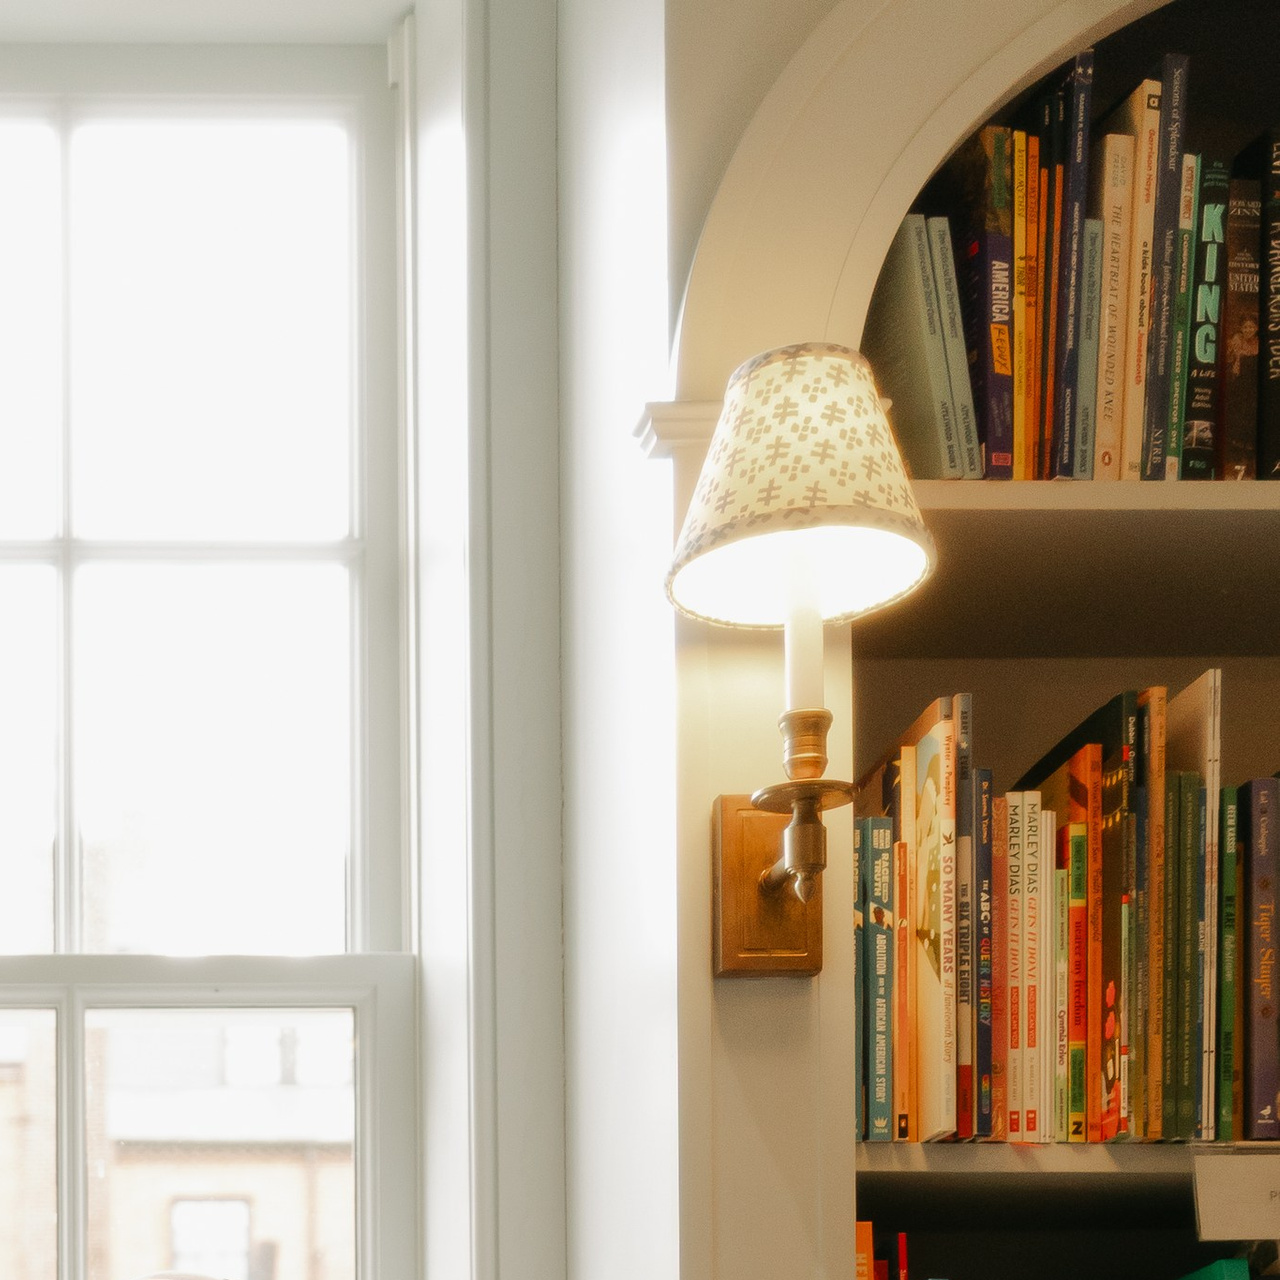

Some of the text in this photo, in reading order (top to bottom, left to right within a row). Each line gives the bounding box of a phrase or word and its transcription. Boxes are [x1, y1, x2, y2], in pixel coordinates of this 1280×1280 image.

[1168, 68, 1182, 172] Seasons of Splendour
[1144, 129, 1155, 203] Garrison Hayes
[1228, 208, 1261, 217] ZINN
[1179, 234, 1190, 293] COMPUTERS
[1194, 203, 1227, 364] KING
[1228, 273, 1260, 283] UNITED
[1228, 283, 1260, 293] STATES
[992, 260, 1009, 371] AMERICA REDUX
[1103, 205, 1122, 421] THE HEARTBEAT OF WOUNDED KNEE
[1135, 250, 1149, 385] kids book about Juneteenth
[1190, 370, 1216, 378] A LIFE
[943, 735, 954, 806] Wynter Pumphrey
[873, 859, 882, 896] TRUTH
[882, 853, 890, 882] RACE
[943, 856, 954, 875] SO
[943, 880, 954, 922] MANY
[1009, 805, 1021, 981] MARLEY DIAS GETS IT DONE
[1027, 804, 1039, 981] MARLEY DIAS GETS IT DONE
[943, 928, 954, 974] YEARS
[959, 901, 970, 1005] SIX TRIPLE EIGHT
[980, 938, 991, 1026] QUEER HISTORY
[1072, 921, 1084, 1026] nearer my freedom
[1254, 904, 1275, 1000] Tiger Slayer
[876, 934, 886, 1102] ABOLITION AFRICAN AMERICAN STORY
[943, 991, 954, 1038] Juneteenth
[1057, 1010, 1067, 1066] Cynthia Erivo
[943, 1040, 954, 1064] Story
